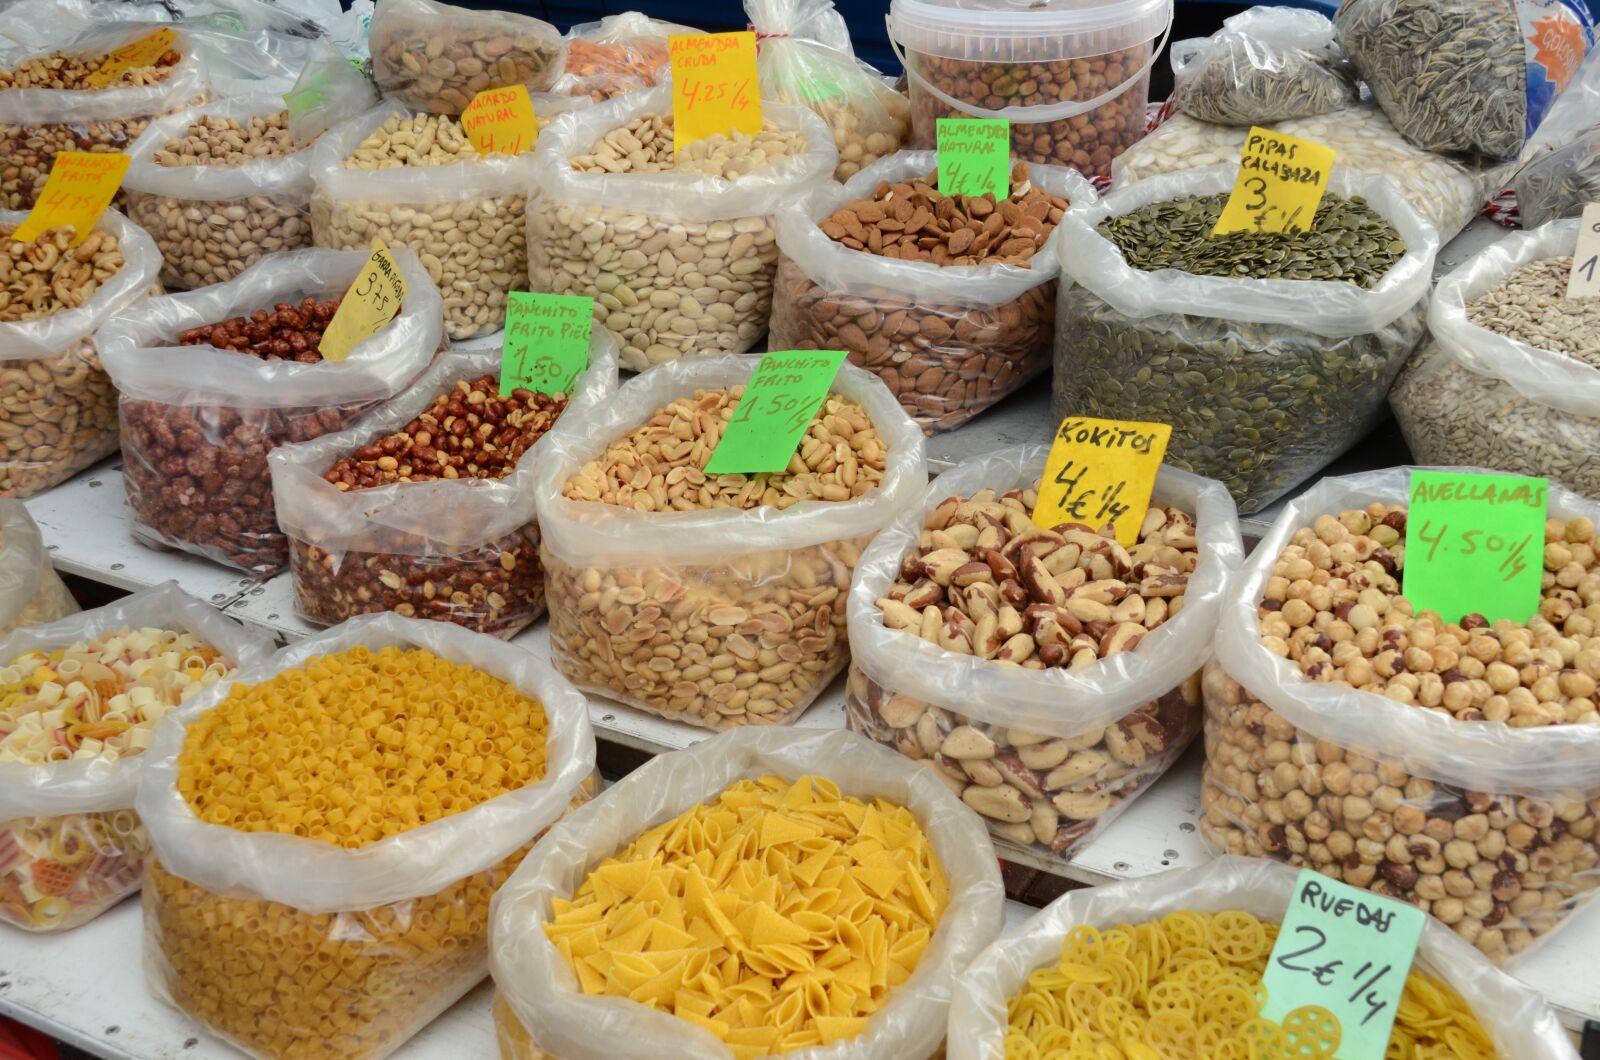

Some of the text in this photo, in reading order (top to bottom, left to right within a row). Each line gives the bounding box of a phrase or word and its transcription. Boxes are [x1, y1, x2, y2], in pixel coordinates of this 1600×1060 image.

[671, 37, 740, 53] ALMENDRA
[677, 54, 717, 69] CRUDA
[464, 90, 518, 112] NACARDO
[682, 78, 728, 111] 4.25
[466, 107, 518, 130] NATURAL
[939, 140, 996, 155] NATURAL
[1247, 135, 1298, 160] PIPAS
[508, 297, 578, 319] PANCHITO
[509, 321, 555, 337] FRITO
[758, 357, 832, 373] PANCHITO
[752, 374, 804, 390] FRITO
[733, 394, 799, 424] 1.50
[1058, 421, 1157, 455] KOKITOS
[1411, 480, 1546, 508] AVELLANAS
[1418, 519, 1506, 562] 4.50
[1300, 880, 1397, 934] RUEDAS
